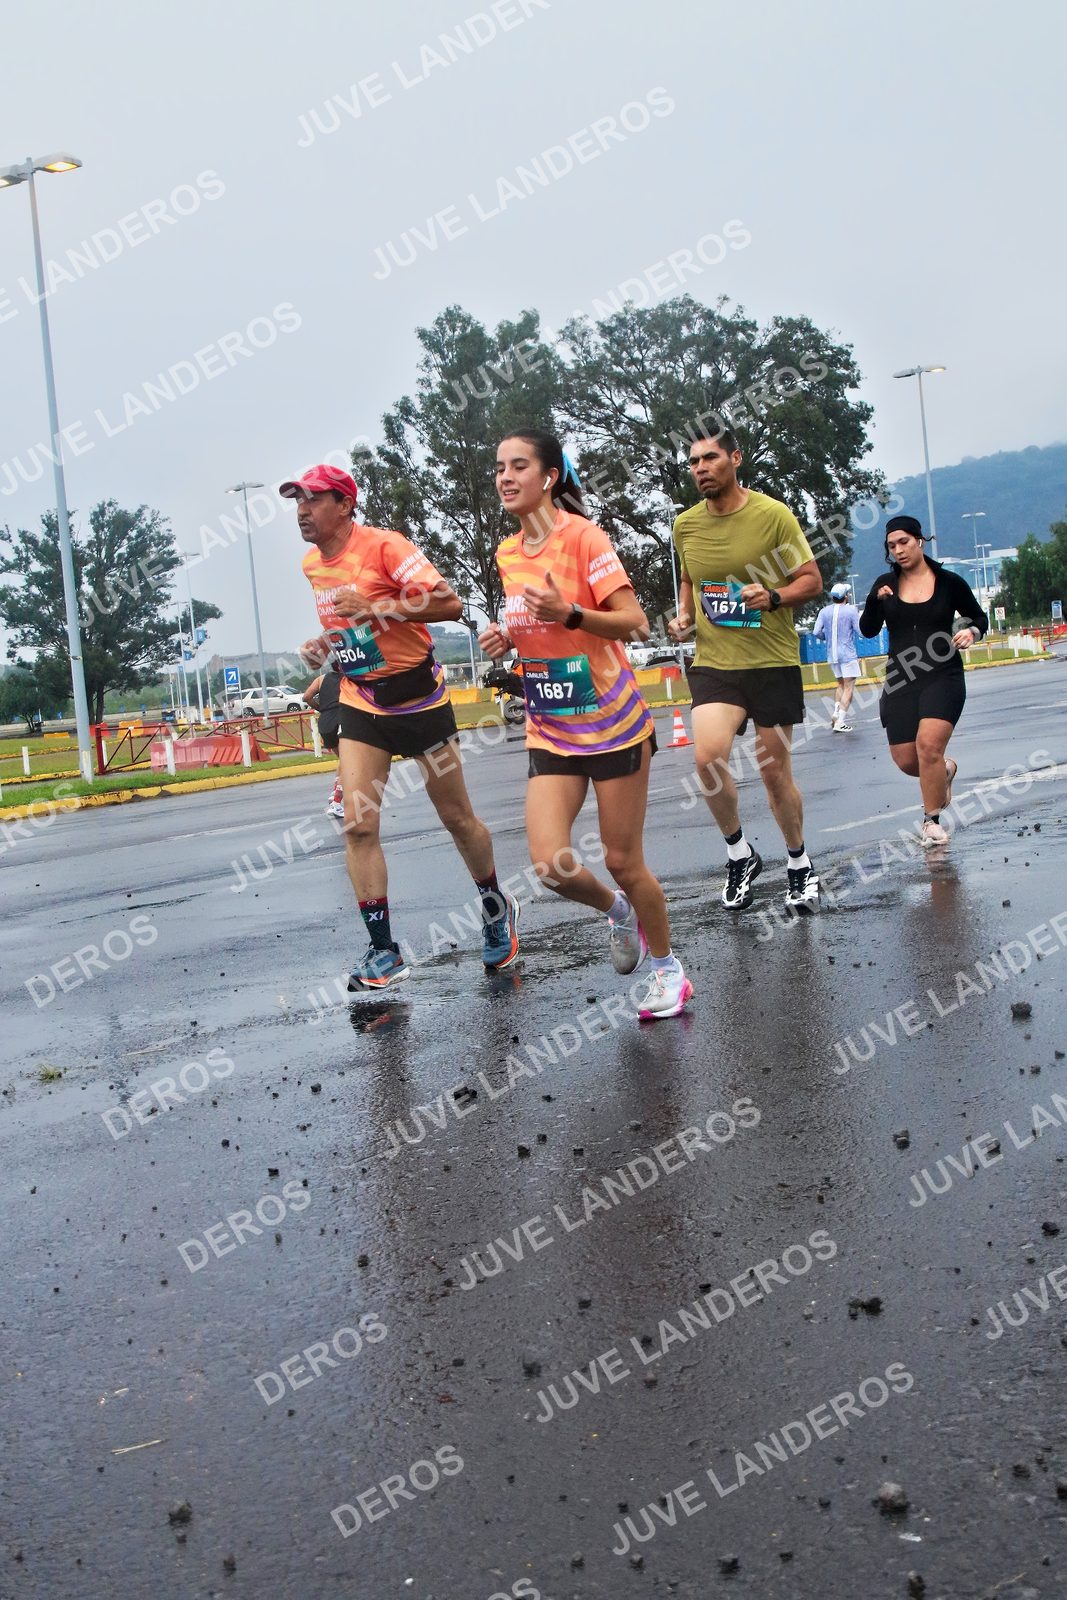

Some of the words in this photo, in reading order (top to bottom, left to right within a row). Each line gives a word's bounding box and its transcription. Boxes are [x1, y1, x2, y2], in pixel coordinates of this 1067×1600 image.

[711, 600, 747, 615] 1671
[336, 648, 366, 664] 1504
[566, 660, 582, 674] 10K
[535, 682, 574, 700] 1687
